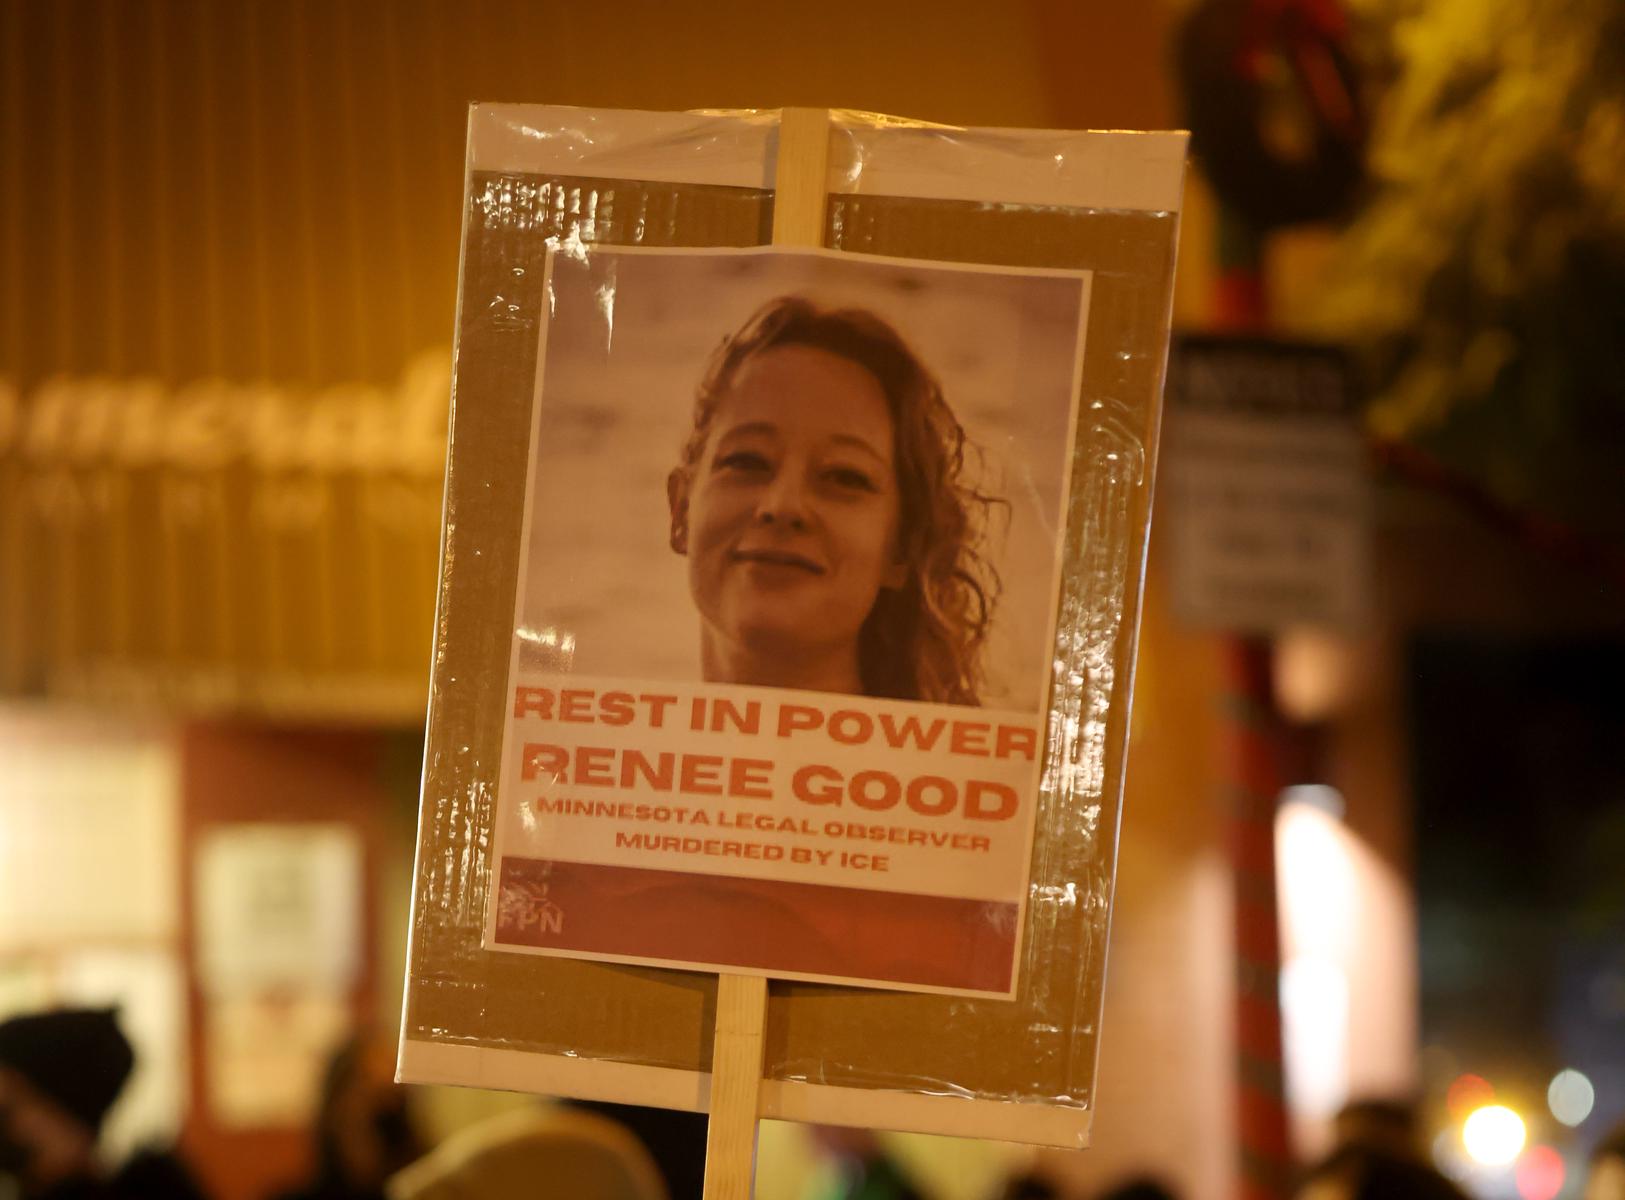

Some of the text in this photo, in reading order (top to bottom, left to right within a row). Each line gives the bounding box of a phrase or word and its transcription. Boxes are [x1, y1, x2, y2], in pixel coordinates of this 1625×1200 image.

[514, 686, 1038, 760] REST IN POWER
[521, 742, 1019, 821] RENEE GOOD
[537, 797, 991, 852] MINNESOTA LEGAL OBSERVER
[615, 832, 890, 872] MURDERED BY ICE
